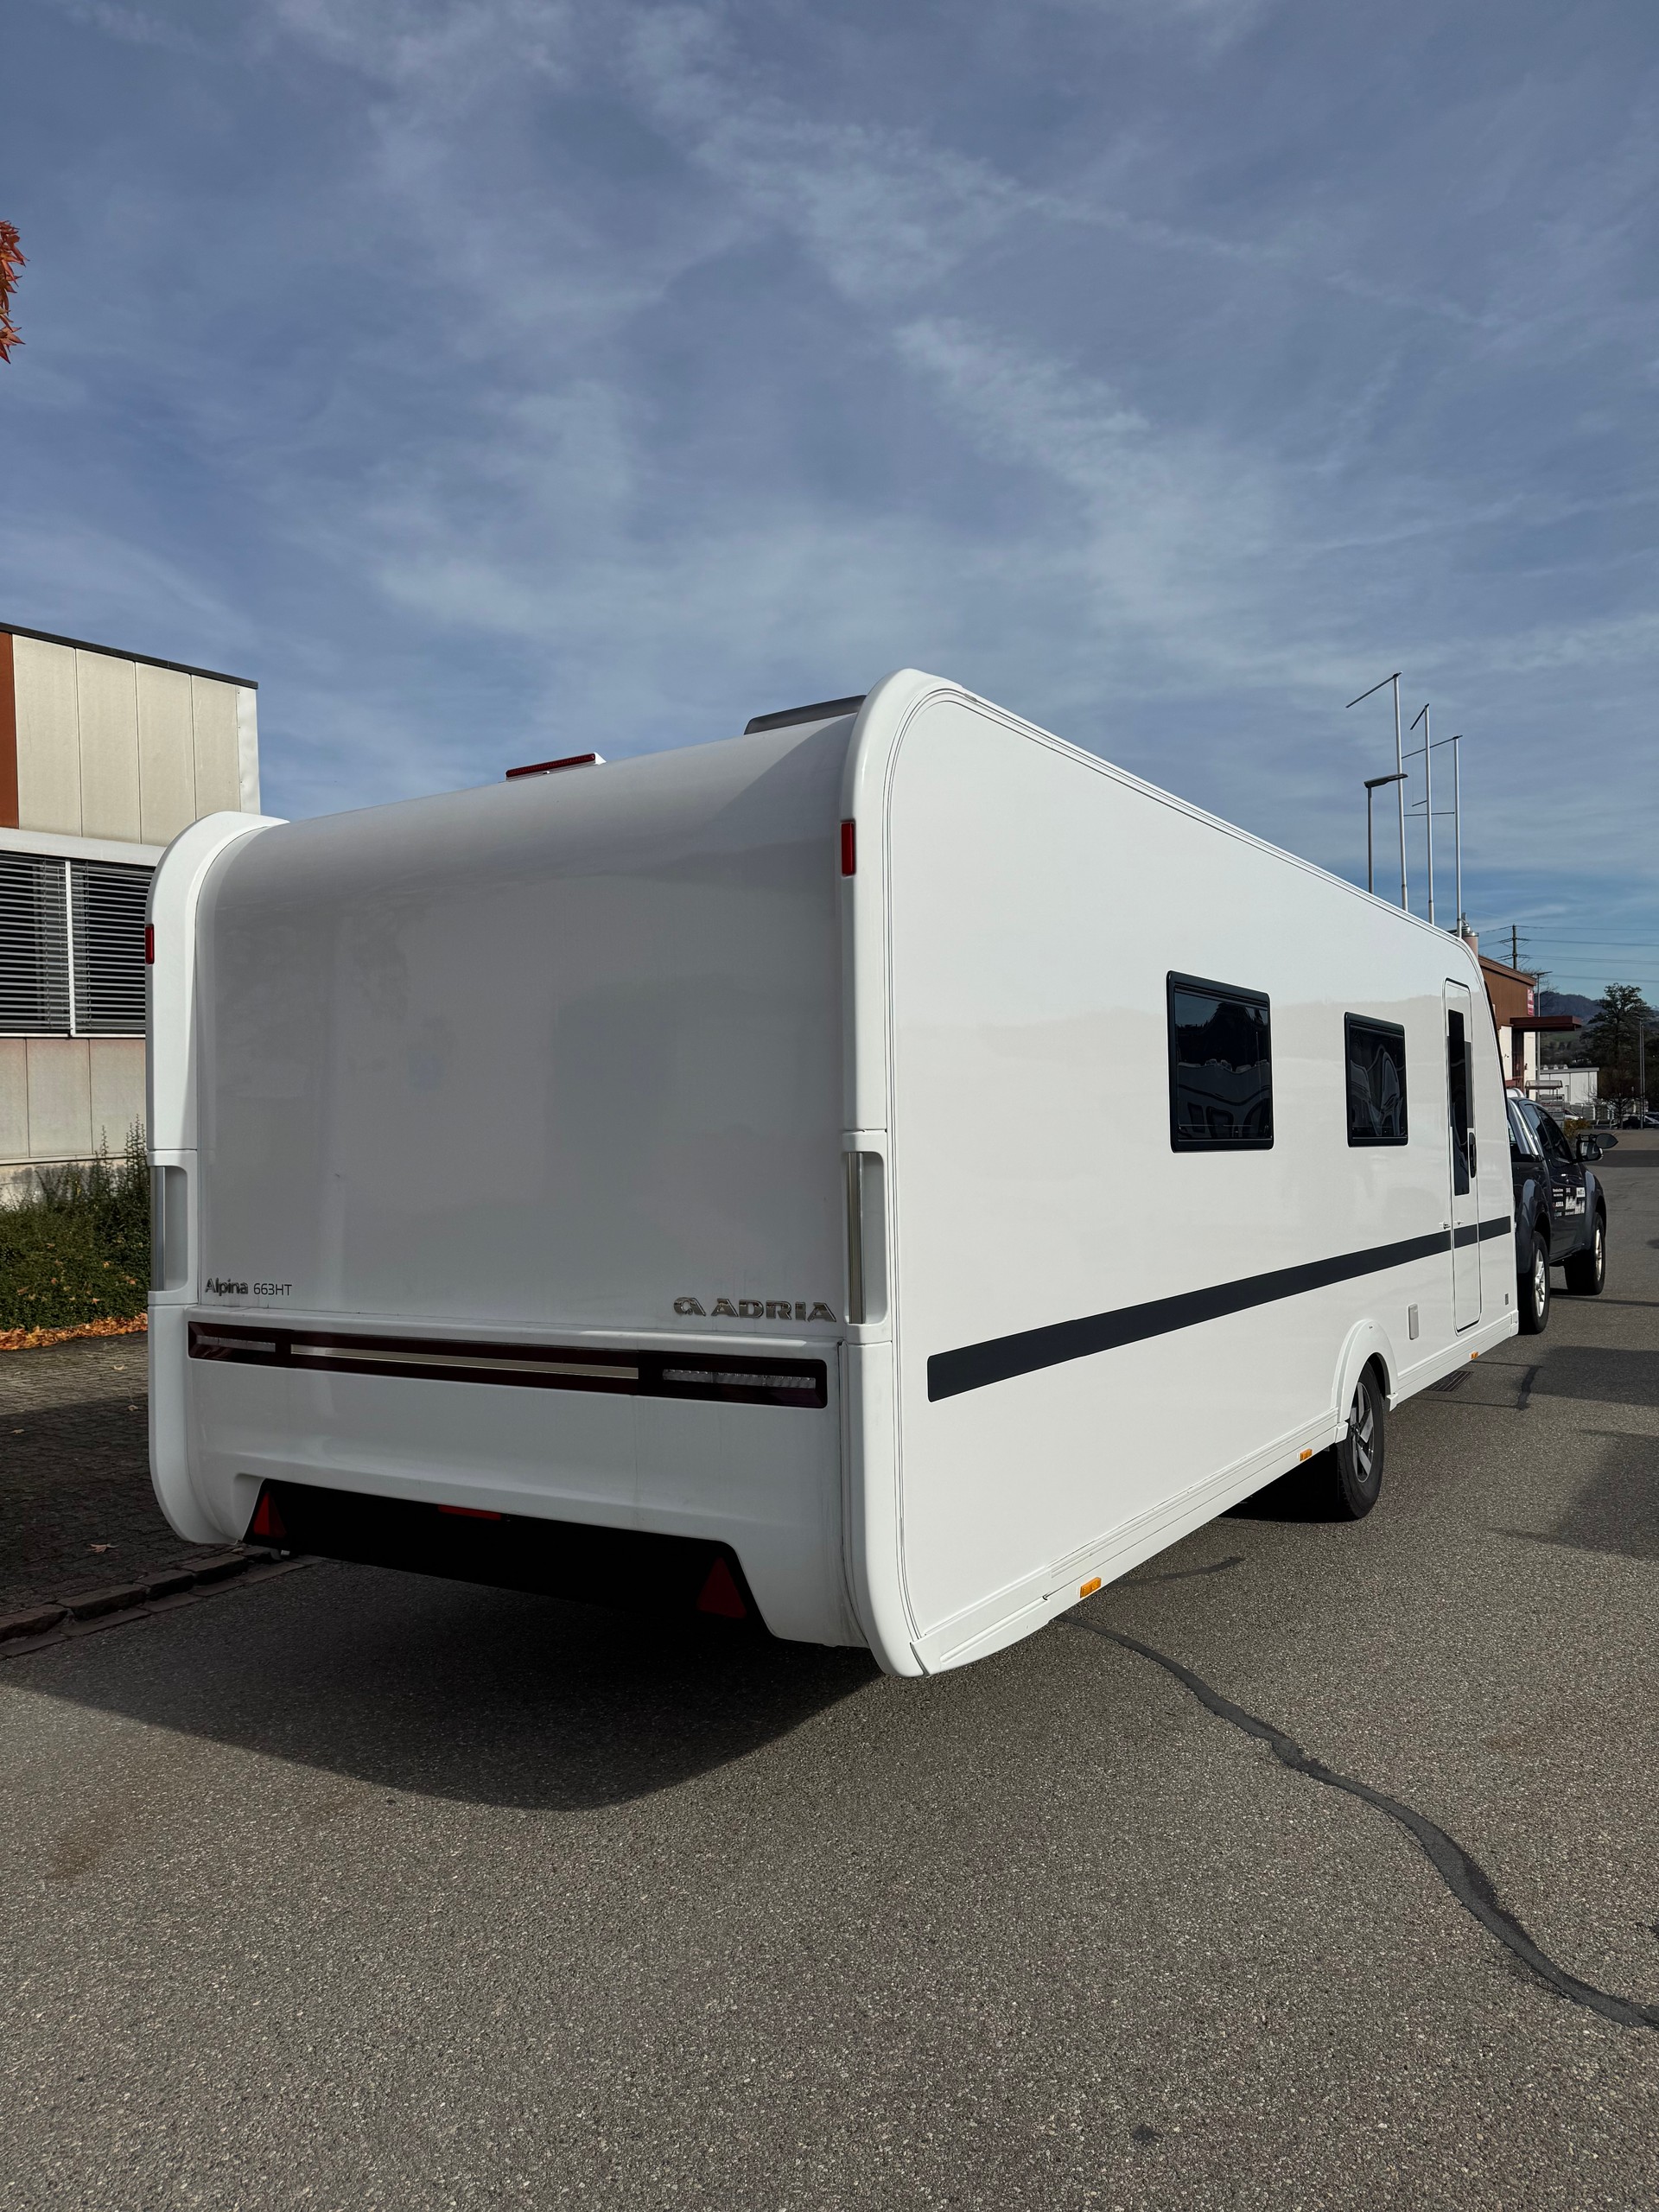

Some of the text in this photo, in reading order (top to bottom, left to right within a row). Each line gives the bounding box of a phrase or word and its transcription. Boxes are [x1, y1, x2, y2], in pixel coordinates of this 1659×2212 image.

[205, 1277, 293, 1296] Alpina 663HT
[710, 1298, 837, 1323] ADRIA
